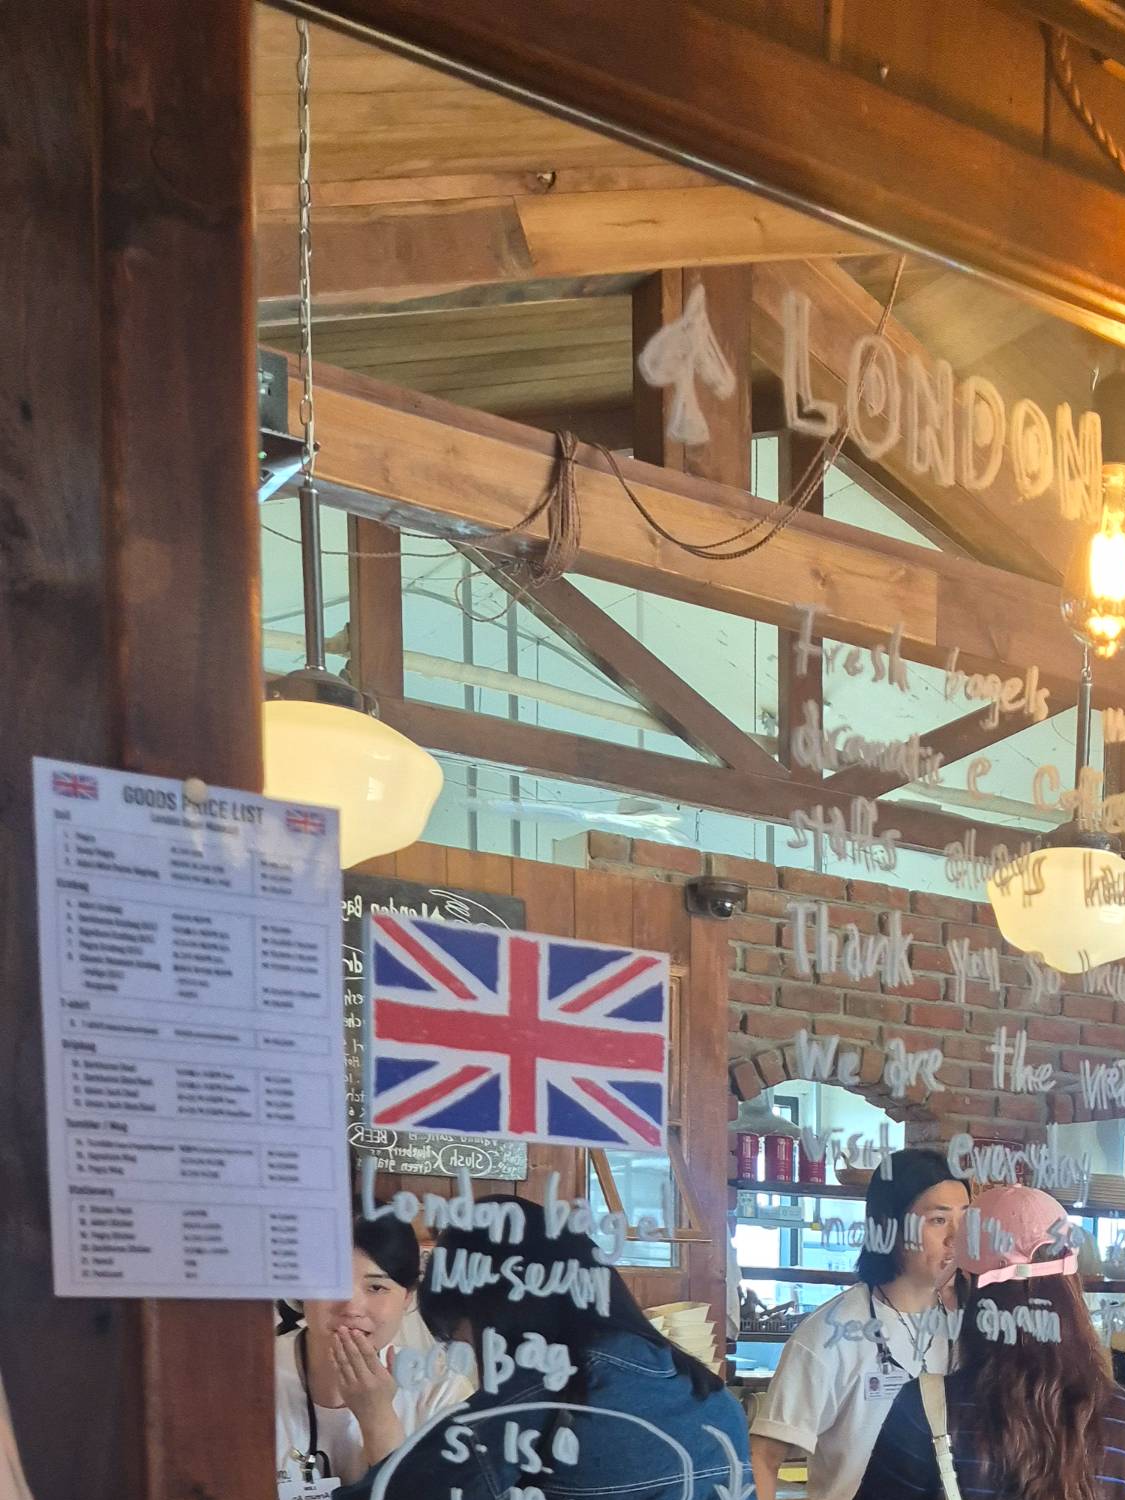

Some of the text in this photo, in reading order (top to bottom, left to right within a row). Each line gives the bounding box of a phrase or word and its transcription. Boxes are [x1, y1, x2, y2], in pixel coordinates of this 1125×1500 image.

[782, 290, 1103, 523] LONDON
[122, 785, 178, 810] GOODS
[232, 802, 265, 824] LIST
[785, 901, 914, 989] Thank
[794, 1028, 862, 1086] We
[985, 1024, 1058, 1094] the
[361, 1157, 526, 1245] London
